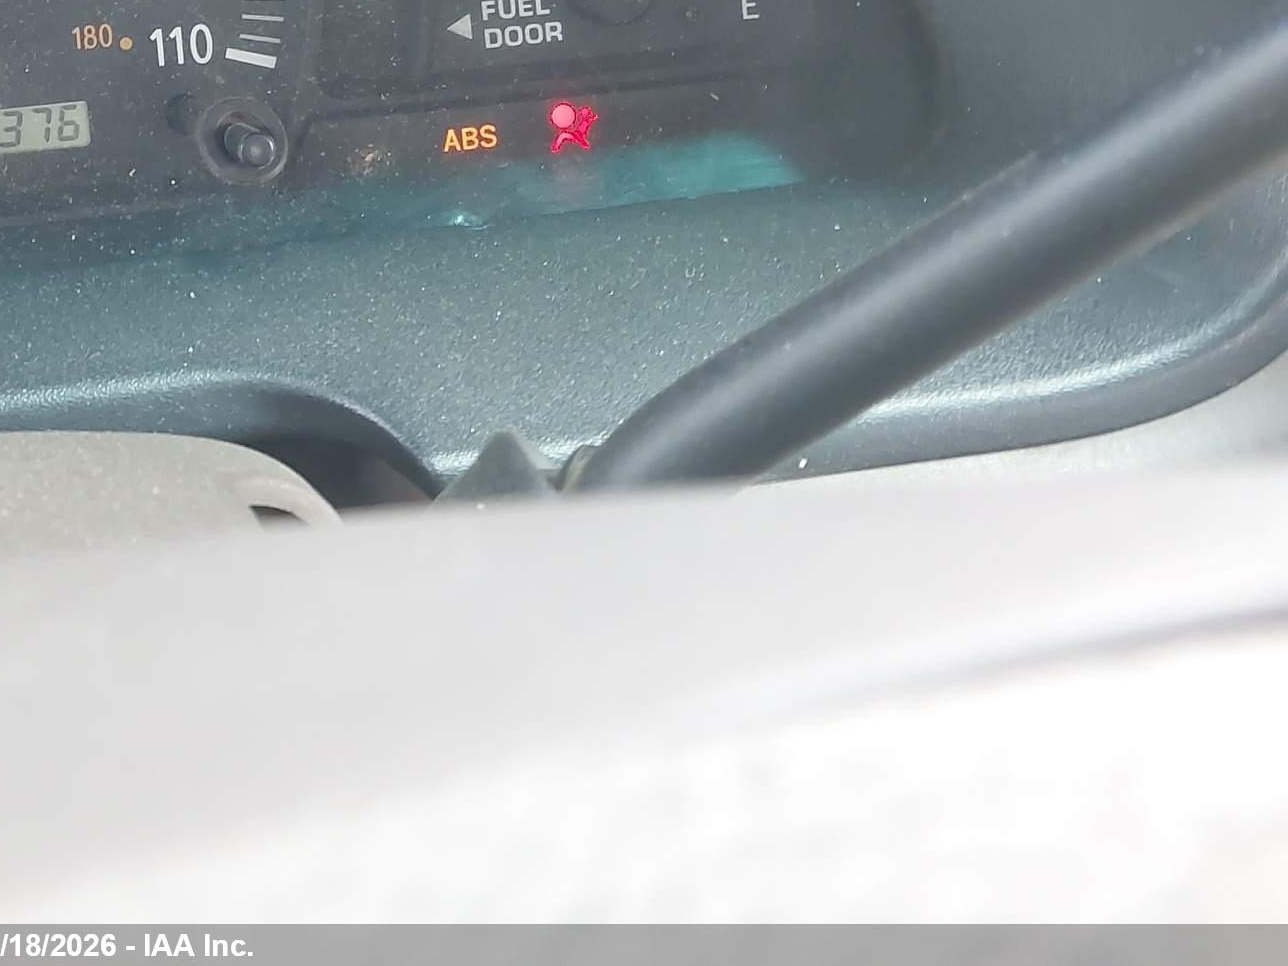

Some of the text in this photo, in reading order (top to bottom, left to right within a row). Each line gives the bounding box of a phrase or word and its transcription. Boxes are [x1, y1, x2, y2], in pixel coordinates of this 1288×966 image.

[71, 23, 113, 50] 180
[149, 23, 213, 67] 110
[484, 21, 563, 49] DOOR
[443, 124, 498, 153] ABS
